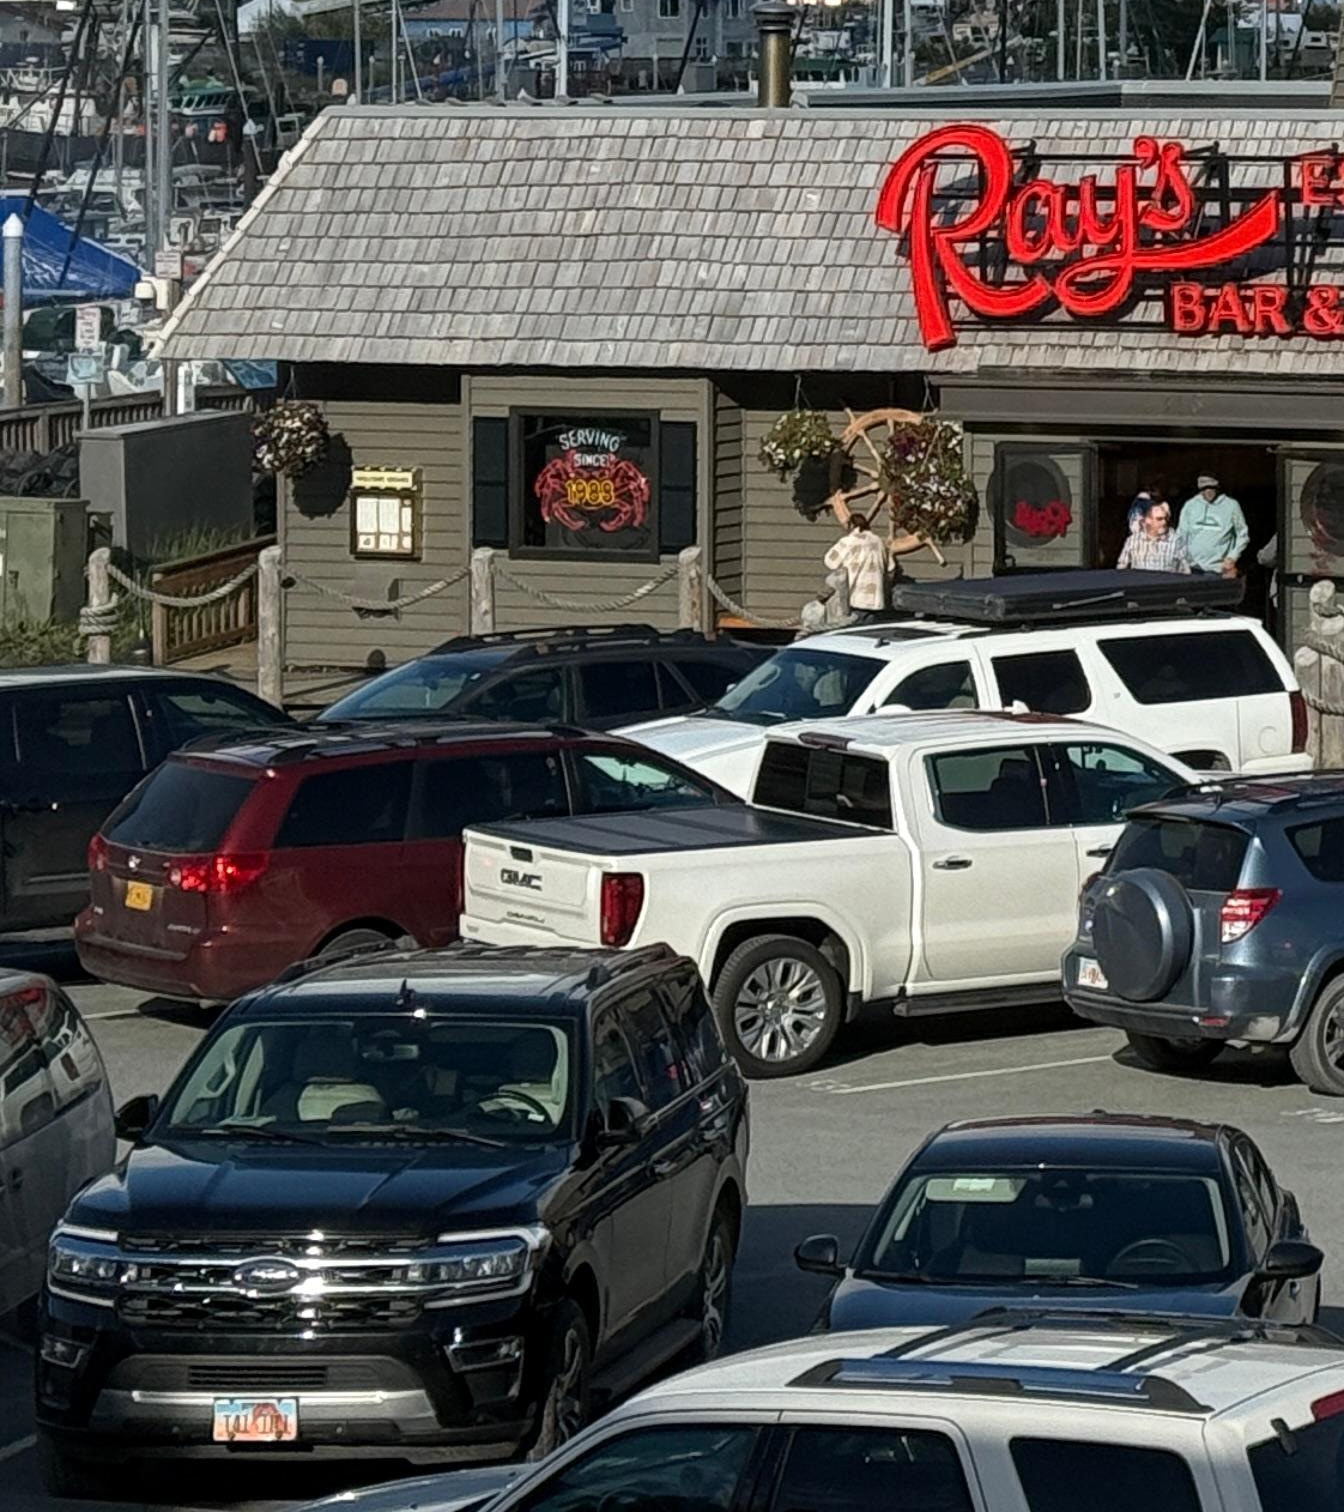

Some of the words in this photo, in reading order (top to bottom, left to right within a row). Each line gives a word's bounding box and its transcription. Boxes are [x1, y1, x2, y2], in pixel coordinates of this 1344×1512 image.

[875, 124, 1280, 352] Ray's
[1174, 282, 1291, 334] BAR
[559, 429, 620, 451] SERVING
[574, 453, 609, 467] SINCE
[500, 868, 542, 891] GMC
